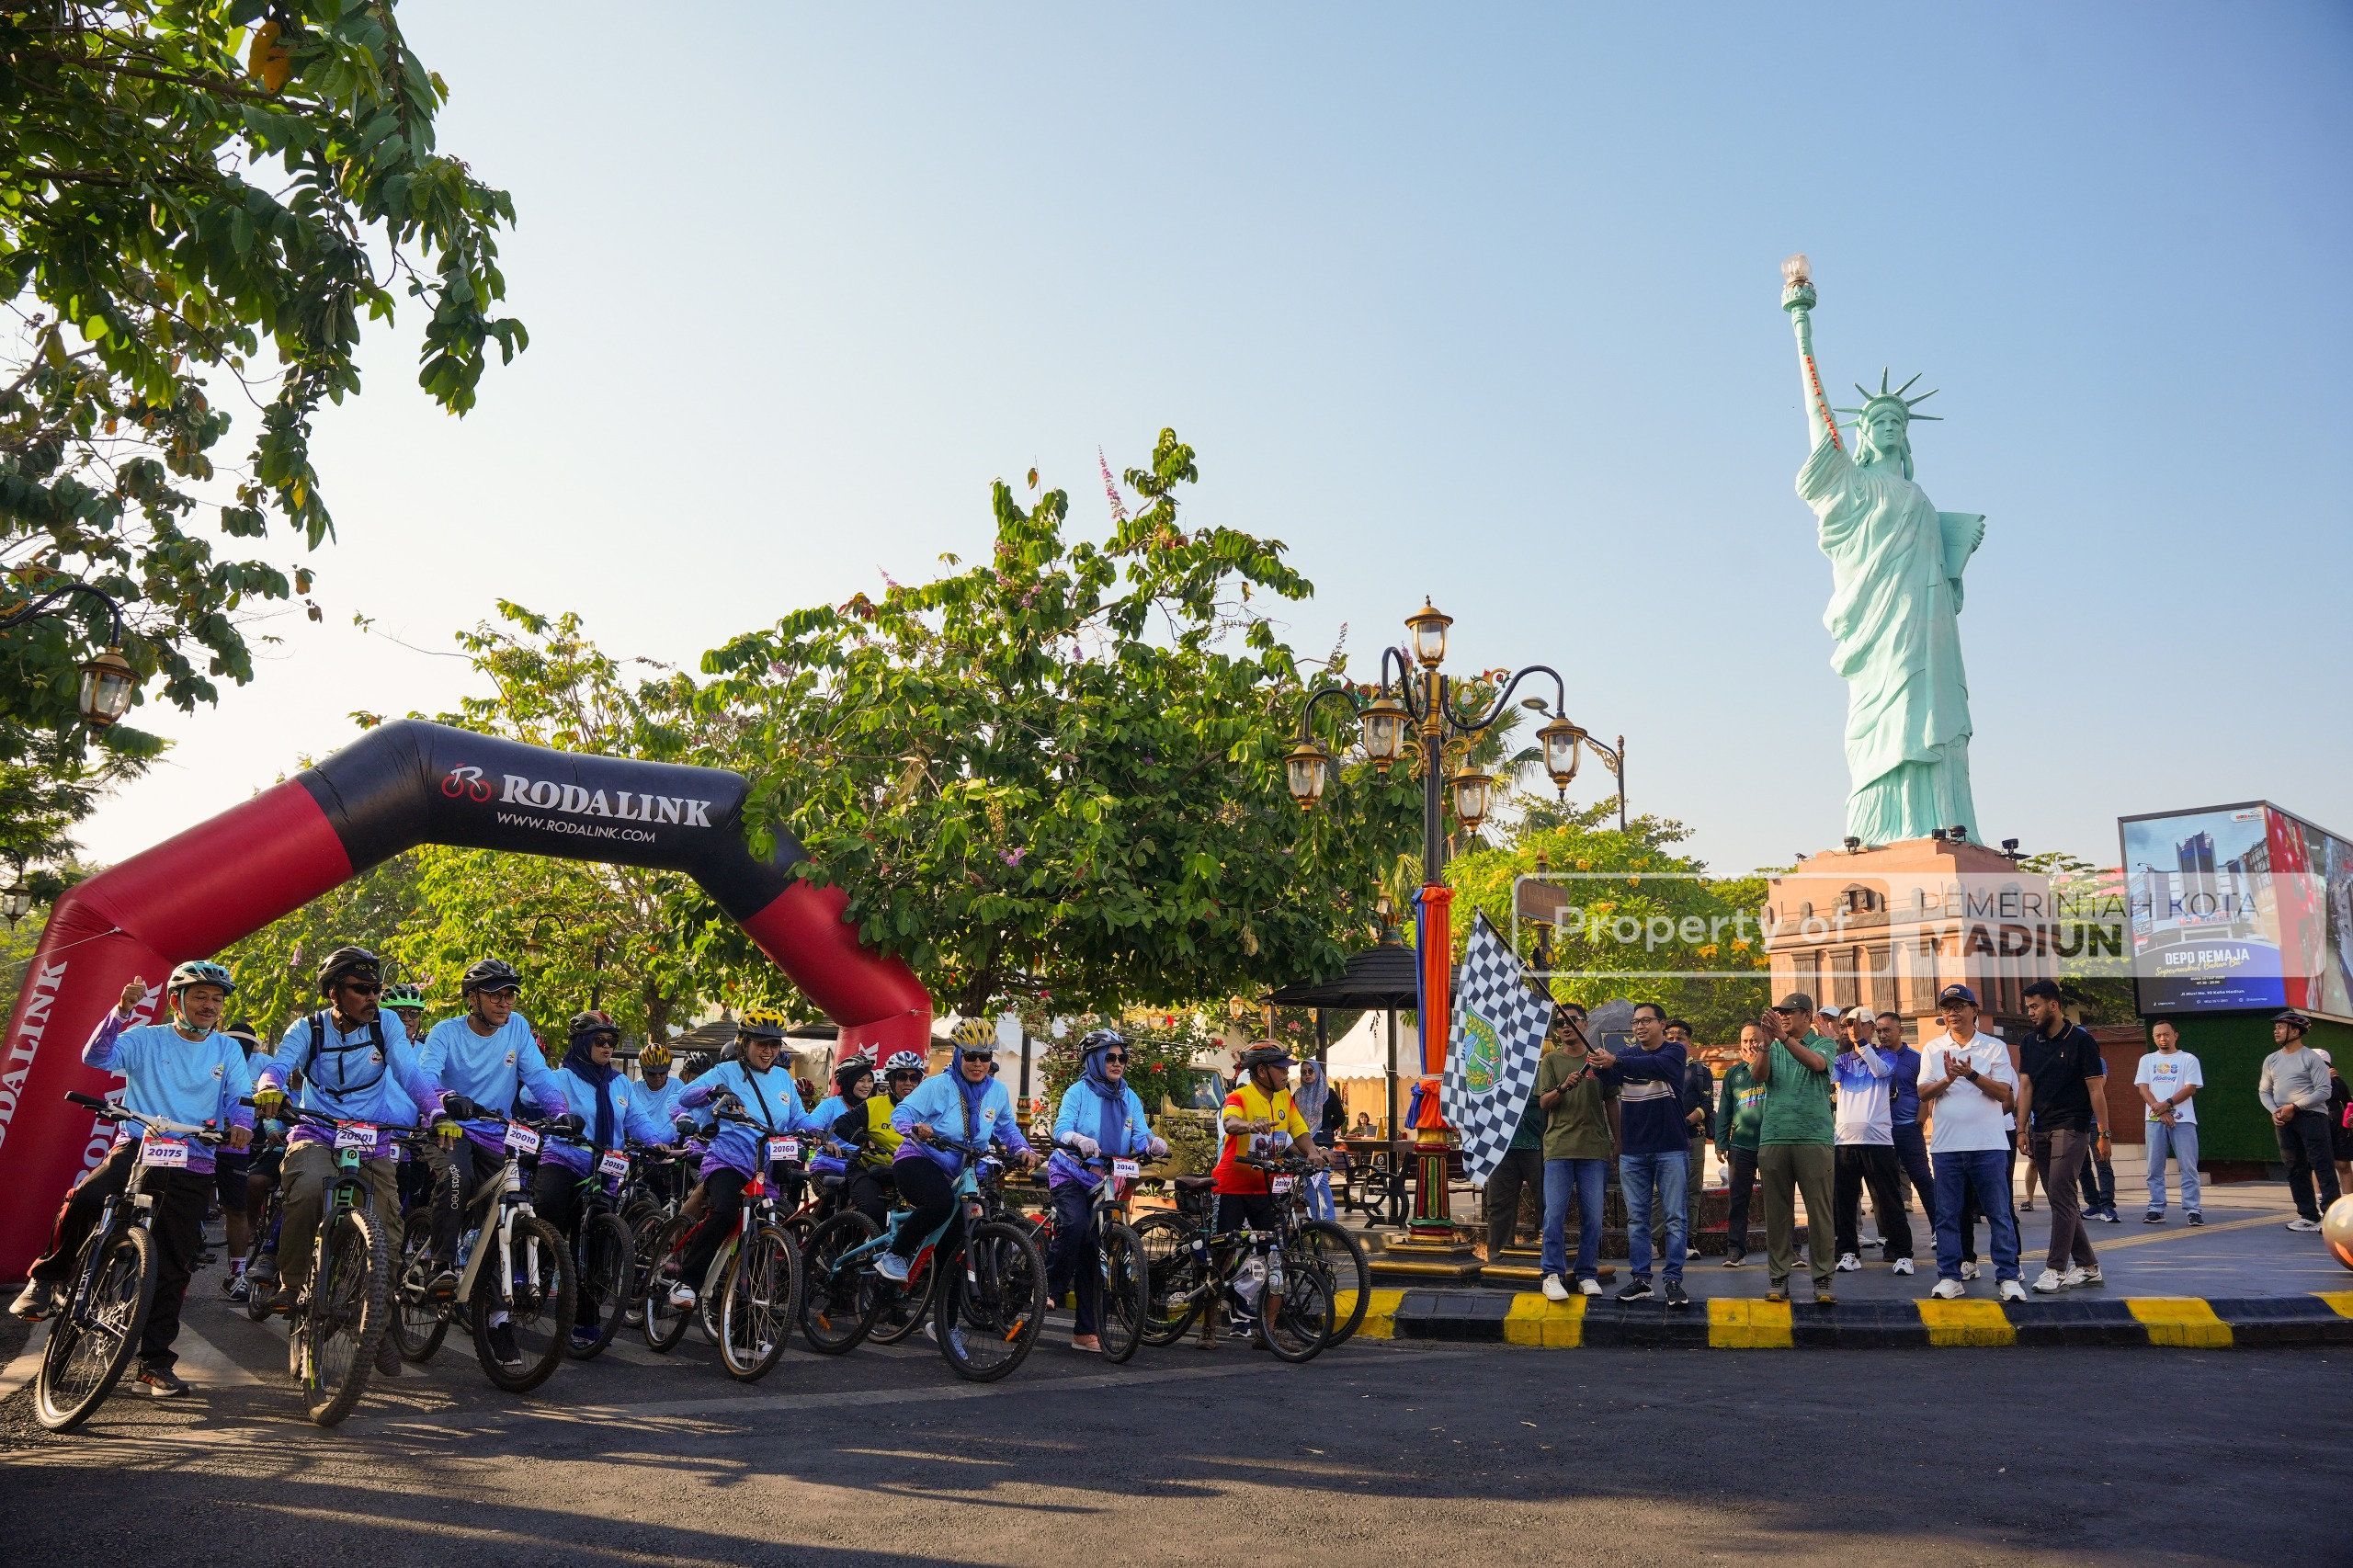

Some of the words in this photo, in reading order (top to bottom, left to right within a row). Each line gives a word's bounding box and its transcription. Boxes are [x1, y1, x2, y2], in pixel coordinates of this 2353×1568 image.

[498, 774, 712, 827] RODALINK
[496, 811, 656, 843] WWW.RODALINK.COM
[2165, 950, 2195, 965] DEPO
[2198, 948, 2250, 964] REMAJA
[509, 1130, 536, 1144] 20010
[147, 1148, 183, 1158] 20175
[603, 1159, 625, 1170] 20159
[449, 1164, 461, 1189] adidas
[450, 1189, 460, 1210] neo
